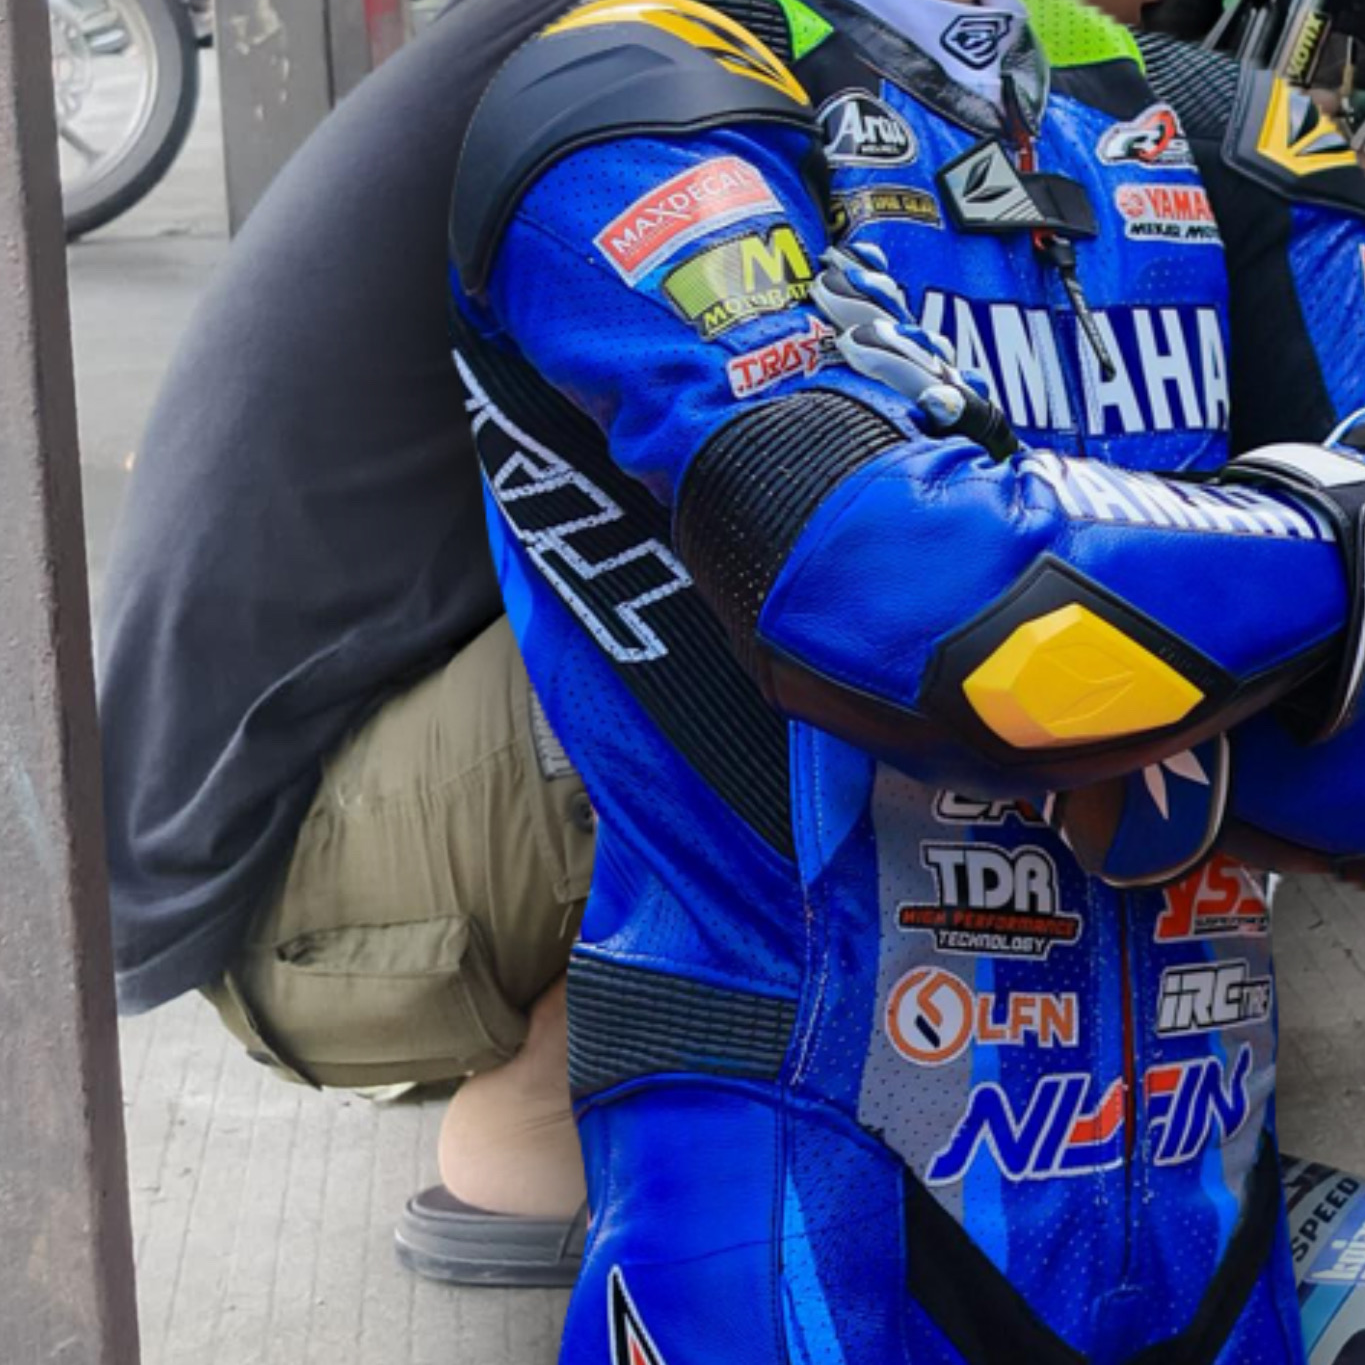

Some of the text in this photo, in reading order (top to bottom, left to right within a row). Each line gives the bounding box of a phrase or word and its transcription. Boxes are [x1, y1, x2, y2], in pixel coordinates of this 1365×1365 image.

[609, 169, 751, 254] MAXDECAL
[926, 847, 1053, 914] TDR
[937, 929, 1046, 953] TECHNOLOGY
[1293, 1177, 1360, 1263] SPEED
